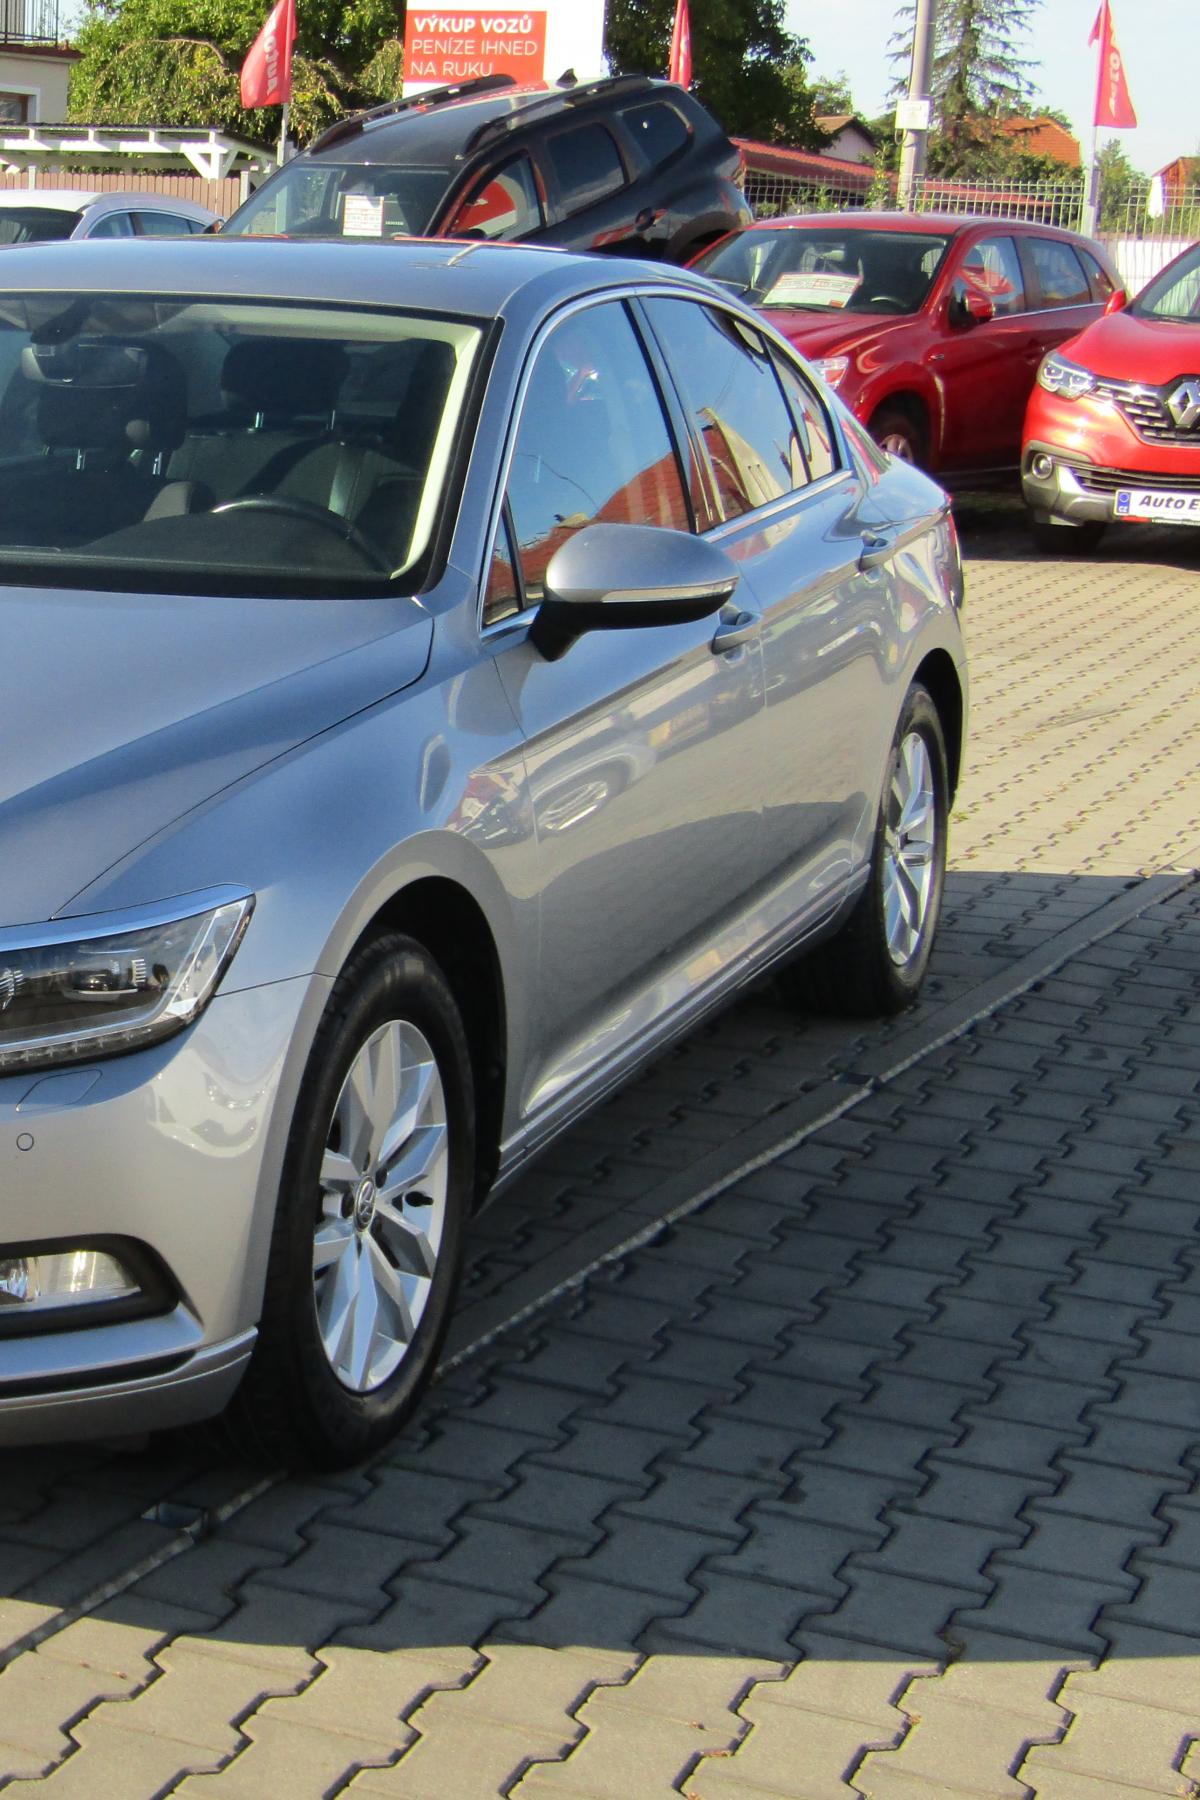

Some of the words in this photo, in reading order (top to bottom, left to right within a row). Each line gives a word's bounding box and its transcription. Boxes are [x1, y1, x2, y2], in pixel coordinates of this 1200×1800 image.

[414, 15, 476, 33] VÝKUP
[480, 15, 533, 34] VOZŮ
[411, 37, 475, 55] PENÍZE
[481, 40, 538, 56] IHNED
[410, 61, 437, 76] NA
[443, 62, 493, 77] RUKU
[1139, 495, 1186, 509] Auto
